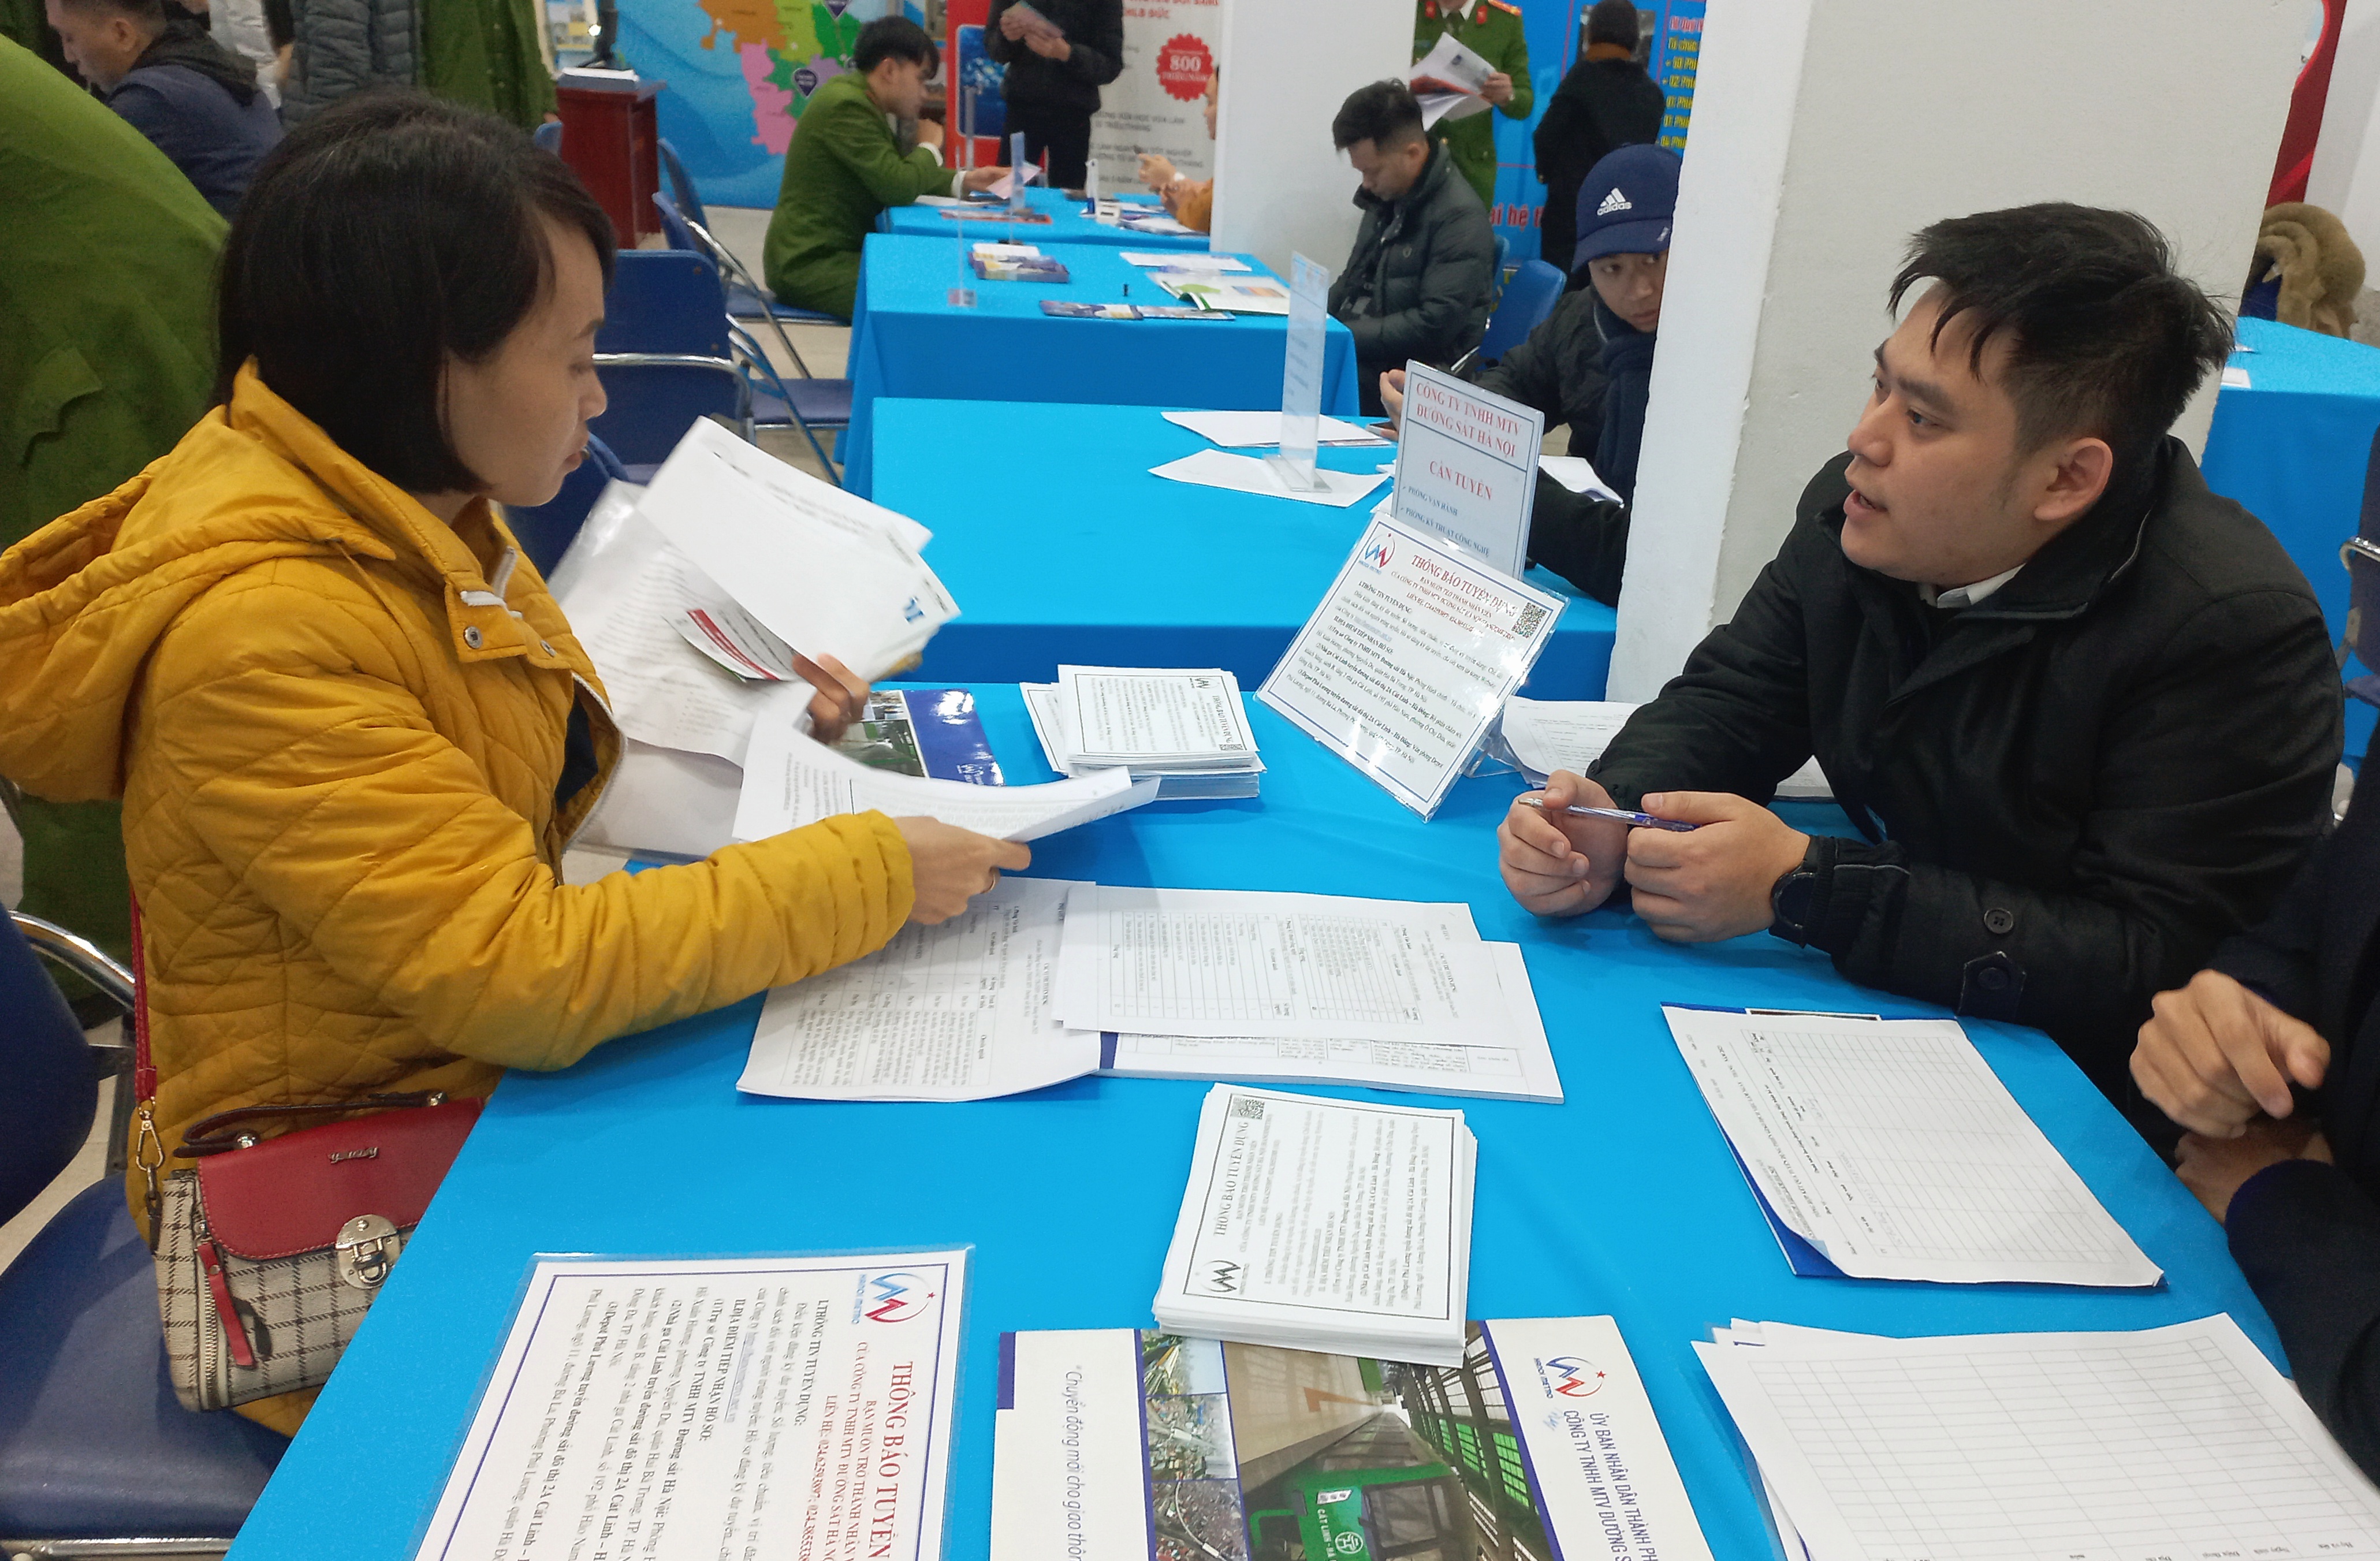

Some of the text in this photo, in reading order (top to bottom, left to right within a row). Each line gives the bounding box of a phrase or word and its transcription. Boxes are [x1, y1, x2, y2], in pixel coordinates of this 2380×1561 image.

[1169, 55, 1201, 72] 800
[1597, 202, 1632, 216] adidas
[1416, 383, 1521, 435] CÔNG TY TNHH MTV
[1417, 403, 1452, 430] ĐƯỜNG
[1477, 429, 1491, 448] HÀ
[1495, 437, 1515, 458] NỘI
[1429, 460, 1492, 500] CẦN TUYỂN
[1408, 485, 1458, 516] PHÒNG VẬN HÀNH
[1405, 507, 1489, 557] PHÒNG KỸ THUẬT CÔNG NGHỆ
[1376, 590, 1384, 598] TIN
[1411, 554, 1442, 577] THÔNG
[1440, 570, 1461, 587] BÁO
[1489, 596, 1517, 617] DỤNG
[1234, 1122, 1248, 1146] DỤNG
[1221, 1180, 1236, 1201] BÁO
[1213, 1204, 1231, 1235] THÔNG
[592, 1336, 608, 1351] Phú
[657, 1339, 671, 1353] Cát
[697, 1336, 714, 1358] Công
[722, 1325, 739, 1350] ĐIỂM
[808, 1340, 821, 1355] TIN
[580, 1354, 601, 1381] Lương
[650, 1355, 666, 1374] Linh
[717, 1352, 732, 1374] TIẾP
[687, 1371, 706, 1399] TNHH
[801, 1358, 817, 1391] TUYỂN
[851, 1363, 866, 1389] CÔNG
[1533, 1357, 1554, 1399] HANOI METRO
[572, 1383, 589, 1406] tuyến
[643, 1377, 658, 1399] tuyến
[708, 1376, 726, 1404] NHẬN
[848, 1392, 860, 1403] TY
[631, 1402, 651, 1430] đường
[681, 1402, 697, 1423] MTV
[705, 1406, 718, 1422] HỒ
[794, 1394, 811, 1425] DỤNG:
[824, 1395, 839, 1417] LIÊN
[862, 1400, 877, 1420] BẠN
[559, 1409, 581, 1437] đường
[818, 1420, 833, 1437] HỆ:
[843, 1407, 858, 1435] TNHH
[1061, 1415, 1083, 1446] động
[1589, 1413, 1609, 1426] ỦY
[668, 1428, 690, 1459] Đường
[699, 1424, 713, 1441] SƠ:
[859, 1422, 873, 1452] MUỐN
[1595, 1429, 1616, 1450] BAN
[624, 1448, 637, 1459] đô
[840, 1437, 853, 1458] MTV
[552, 1455, 565, 1466] đô
[617, 1462, 633, 1474] thị
[868, 1361, 915, 1558] THÔNG BÁO TUYỂN
[1066, 1450, 1083, 1473] mới
[1603, 1452, 1628, 1481] NHÂN
[543, 1469, 560, 1482] thị
[614, 1477, 629, 1491] 2A
[661, 1479, 676, 1493] Hà
[832, 1463, 848, 1502] ĐƯỜNG
[1066, 1476, 1085, 1497] cho
[1563, 1410, 1627, 1552] CÔNG TY TNHH MTV ĐƯỜNG
[539, 1484, 555, 1498] 2A
[849, 1480, 865, 1519] THÀNH
[1614, 1484, 1637, 1505] DÂN
[532, 1501, 549, 1518] Cát
[608, 1494, 624, 1511] Cát
[654, 1497, 672, 1518] Nội:
[1062, 1500, 1085, 1529] giao
[523, 1522, 542, 1545] Linh
[599, 1515, 619, 1538] Linh
[1624, 1508, 1651, 1544] THÀNH
[825, 1529, 840, 1546] HÀ
[844, 1522, 860, 1554] NHÂN
